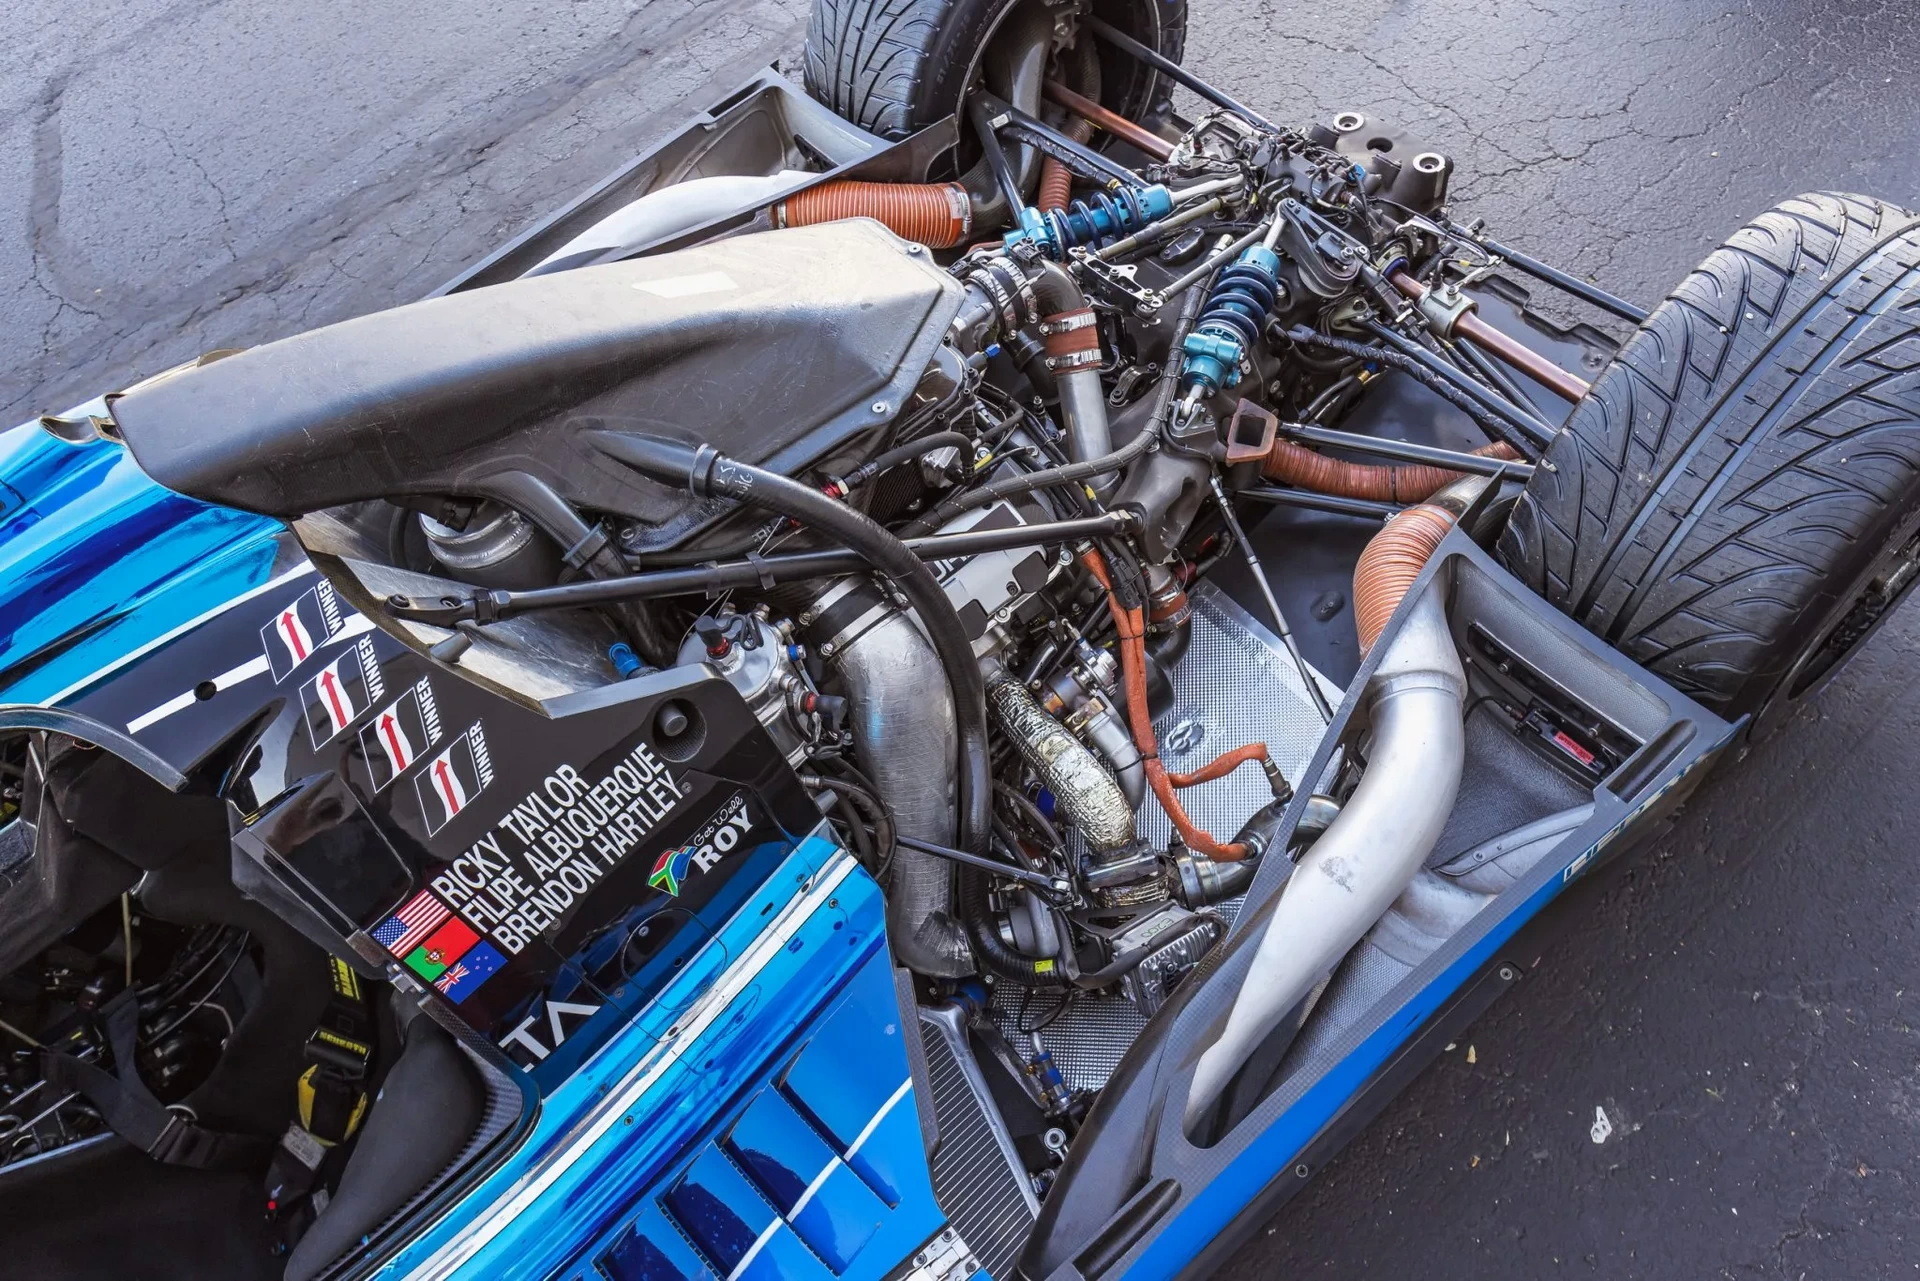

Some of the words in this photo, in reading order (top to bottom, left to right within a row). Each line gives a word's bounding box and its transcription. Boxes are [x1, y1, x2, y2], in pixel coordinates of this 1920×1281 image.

[317, 577, 346, 636] WINNER
[358, 633, 386, 704] WINNER
[416, 675, 444, 746] WINNER
[468, 719, 495, 790] WINNER
[430, 832, 511, 910] RICKY
[498, 764, 590, 846] TAYLOR
[460, 865, 535, 934] FILIPE
[523, 742, 665, 882] ALBUQUERQUE
[691, 804, 753, 875] ROY
[693, 825, 715, 847] Get
[712, 795, 743, 825] Well
[491, 851, 603, 955] BRENDON
[590, 769, 683, 866] HARTLEY
[498, 1000, 601, 1074] TA
